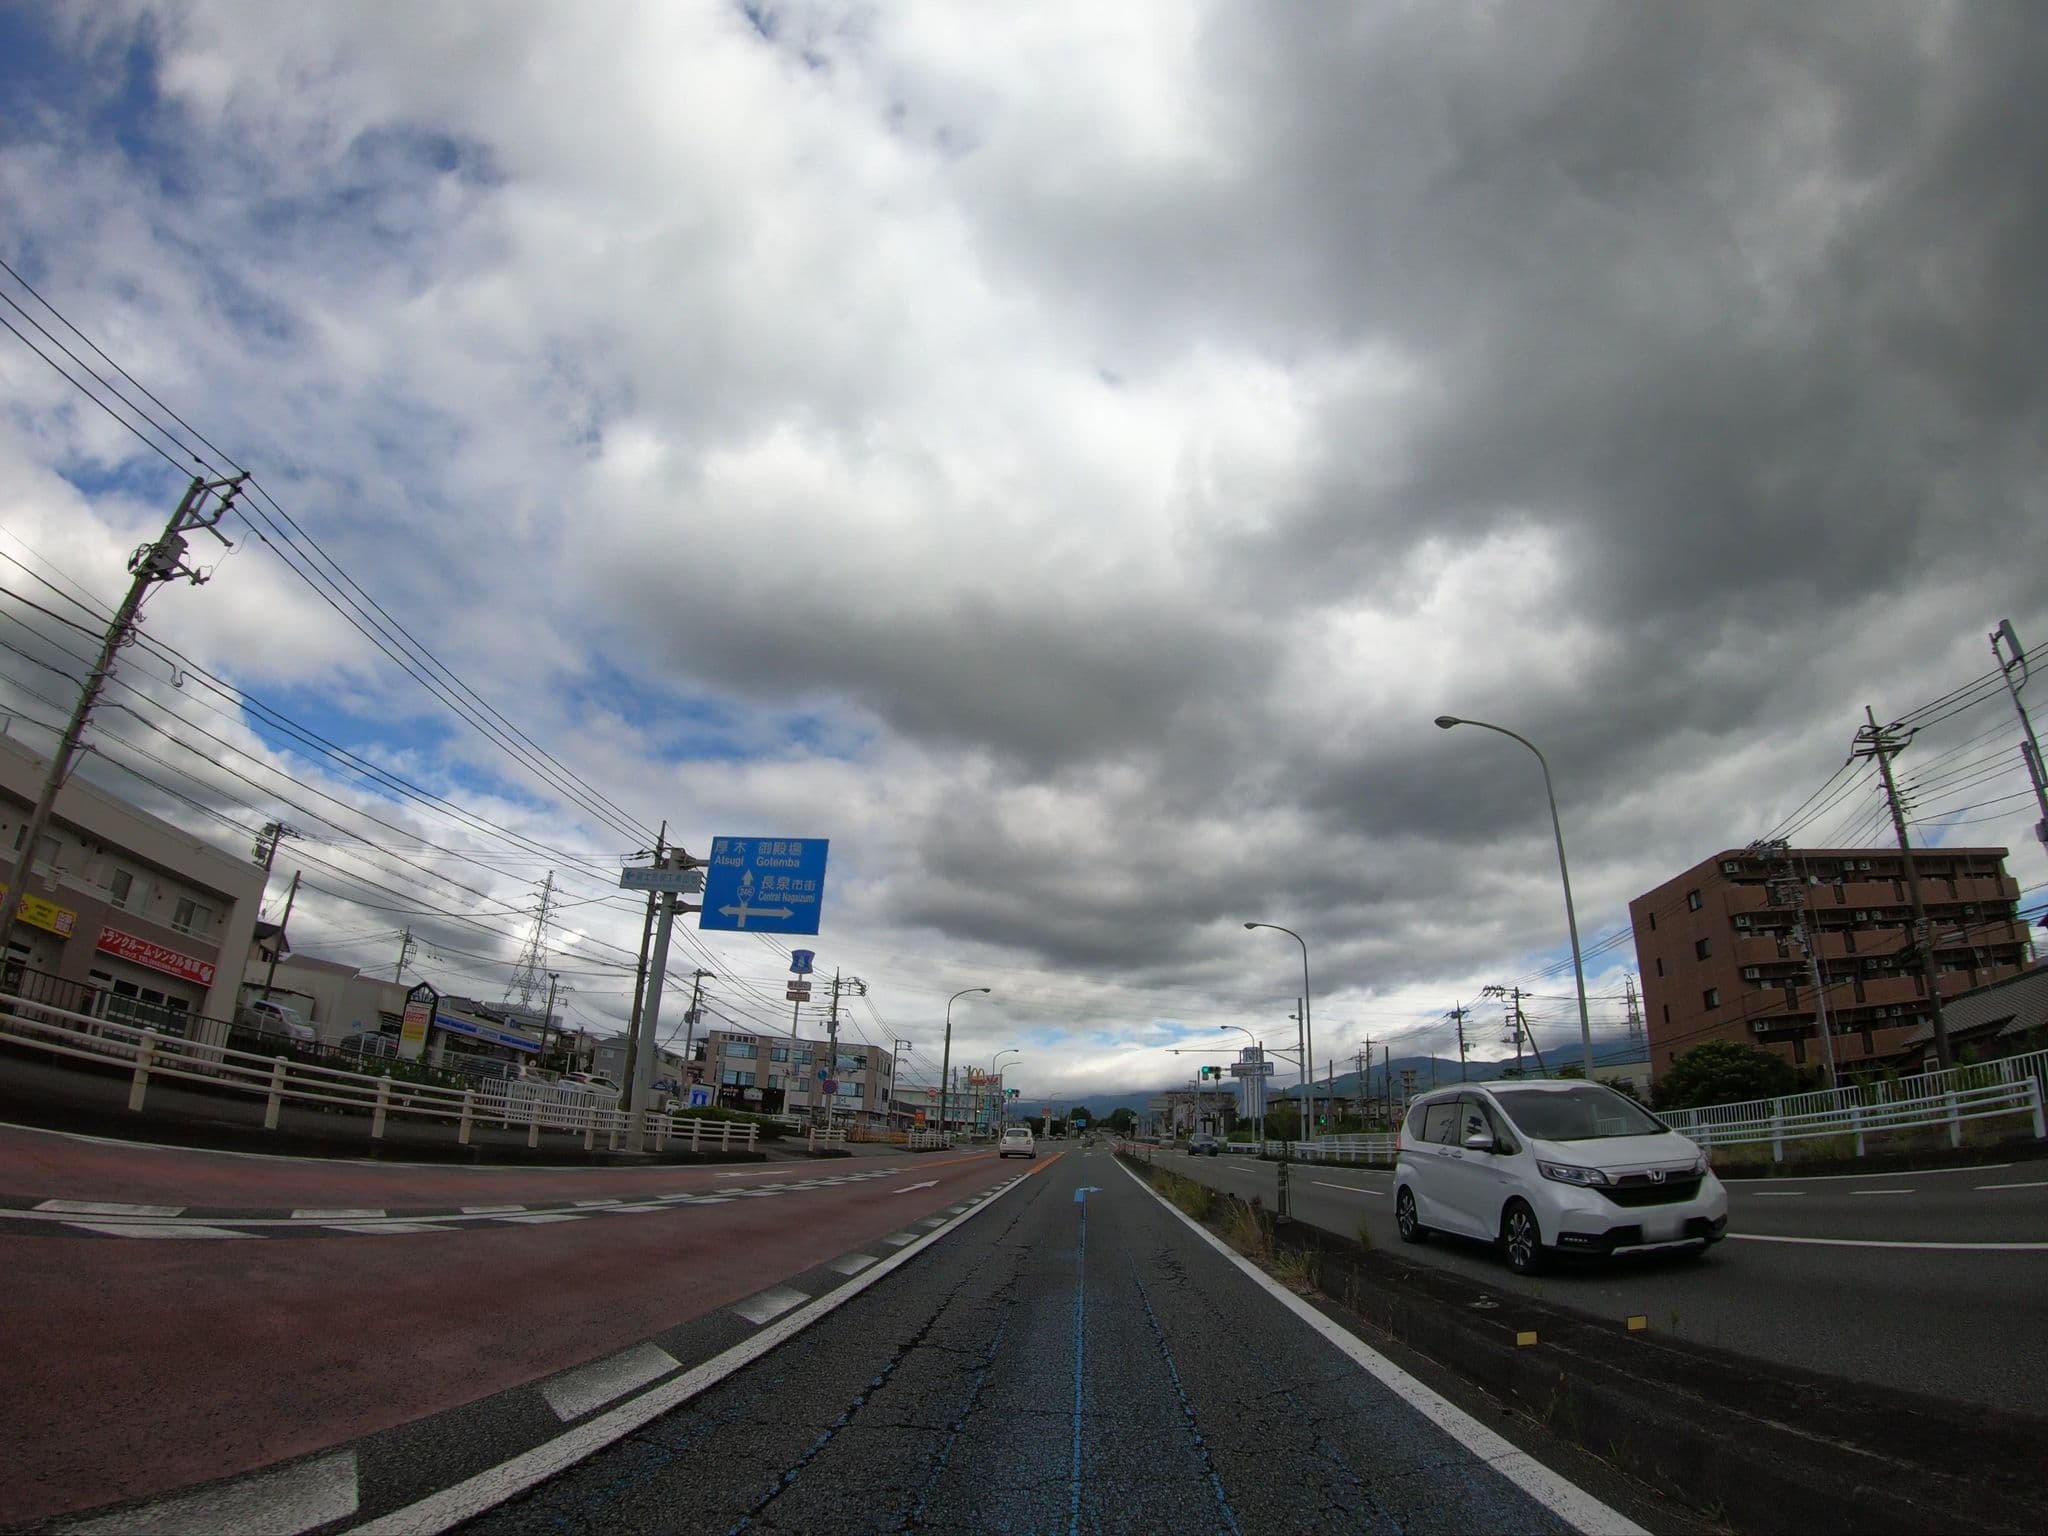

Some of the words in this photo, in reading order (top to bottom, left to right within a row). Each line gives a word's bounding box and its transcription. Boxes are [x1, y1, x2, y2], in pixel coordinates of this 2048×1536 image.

[716, 840, 746, 854] 厚木
[758, 842, 801, 856] 御殿場
[715, 856, 744, 867] Atsugi
[756, 857, 800, 867] Gotemba
